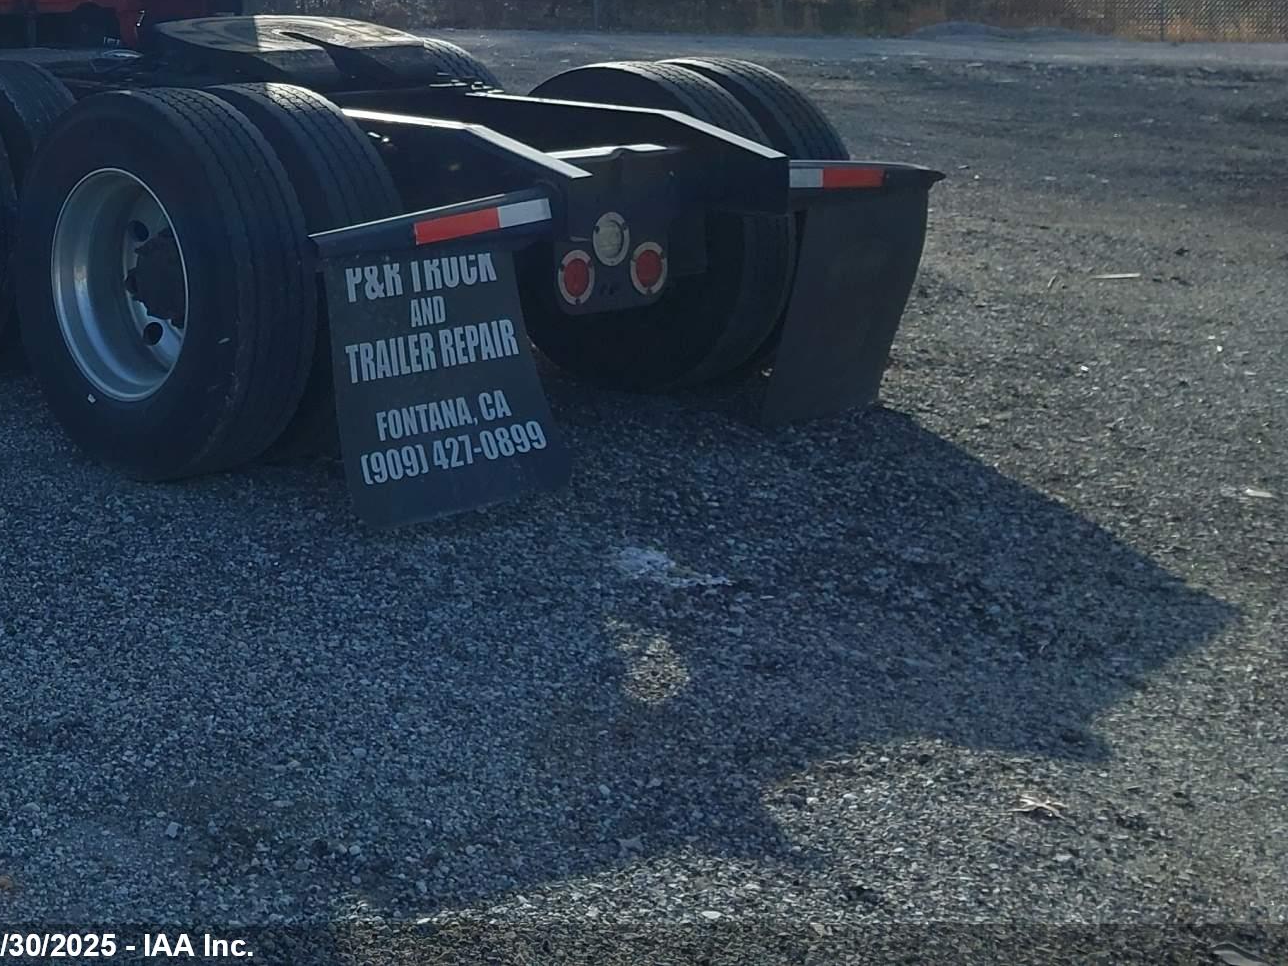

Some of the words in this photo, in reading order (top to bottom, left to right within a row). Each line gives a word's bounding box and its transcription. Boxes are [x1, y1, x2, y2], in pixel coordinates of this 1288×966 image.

[410, 252, 497, 293] TRUCK
[410, 295, 447, 328] AND
[345, 332, 437, 383] TRAILER
[438, 319, 520, 368] REPAIR
[376, 396, 479, 442] FONTANA,
[478, 389, 512, 421] CA
[360, 444, 430, 485] (909)
[432, 420, 548, 470] 427-0899
